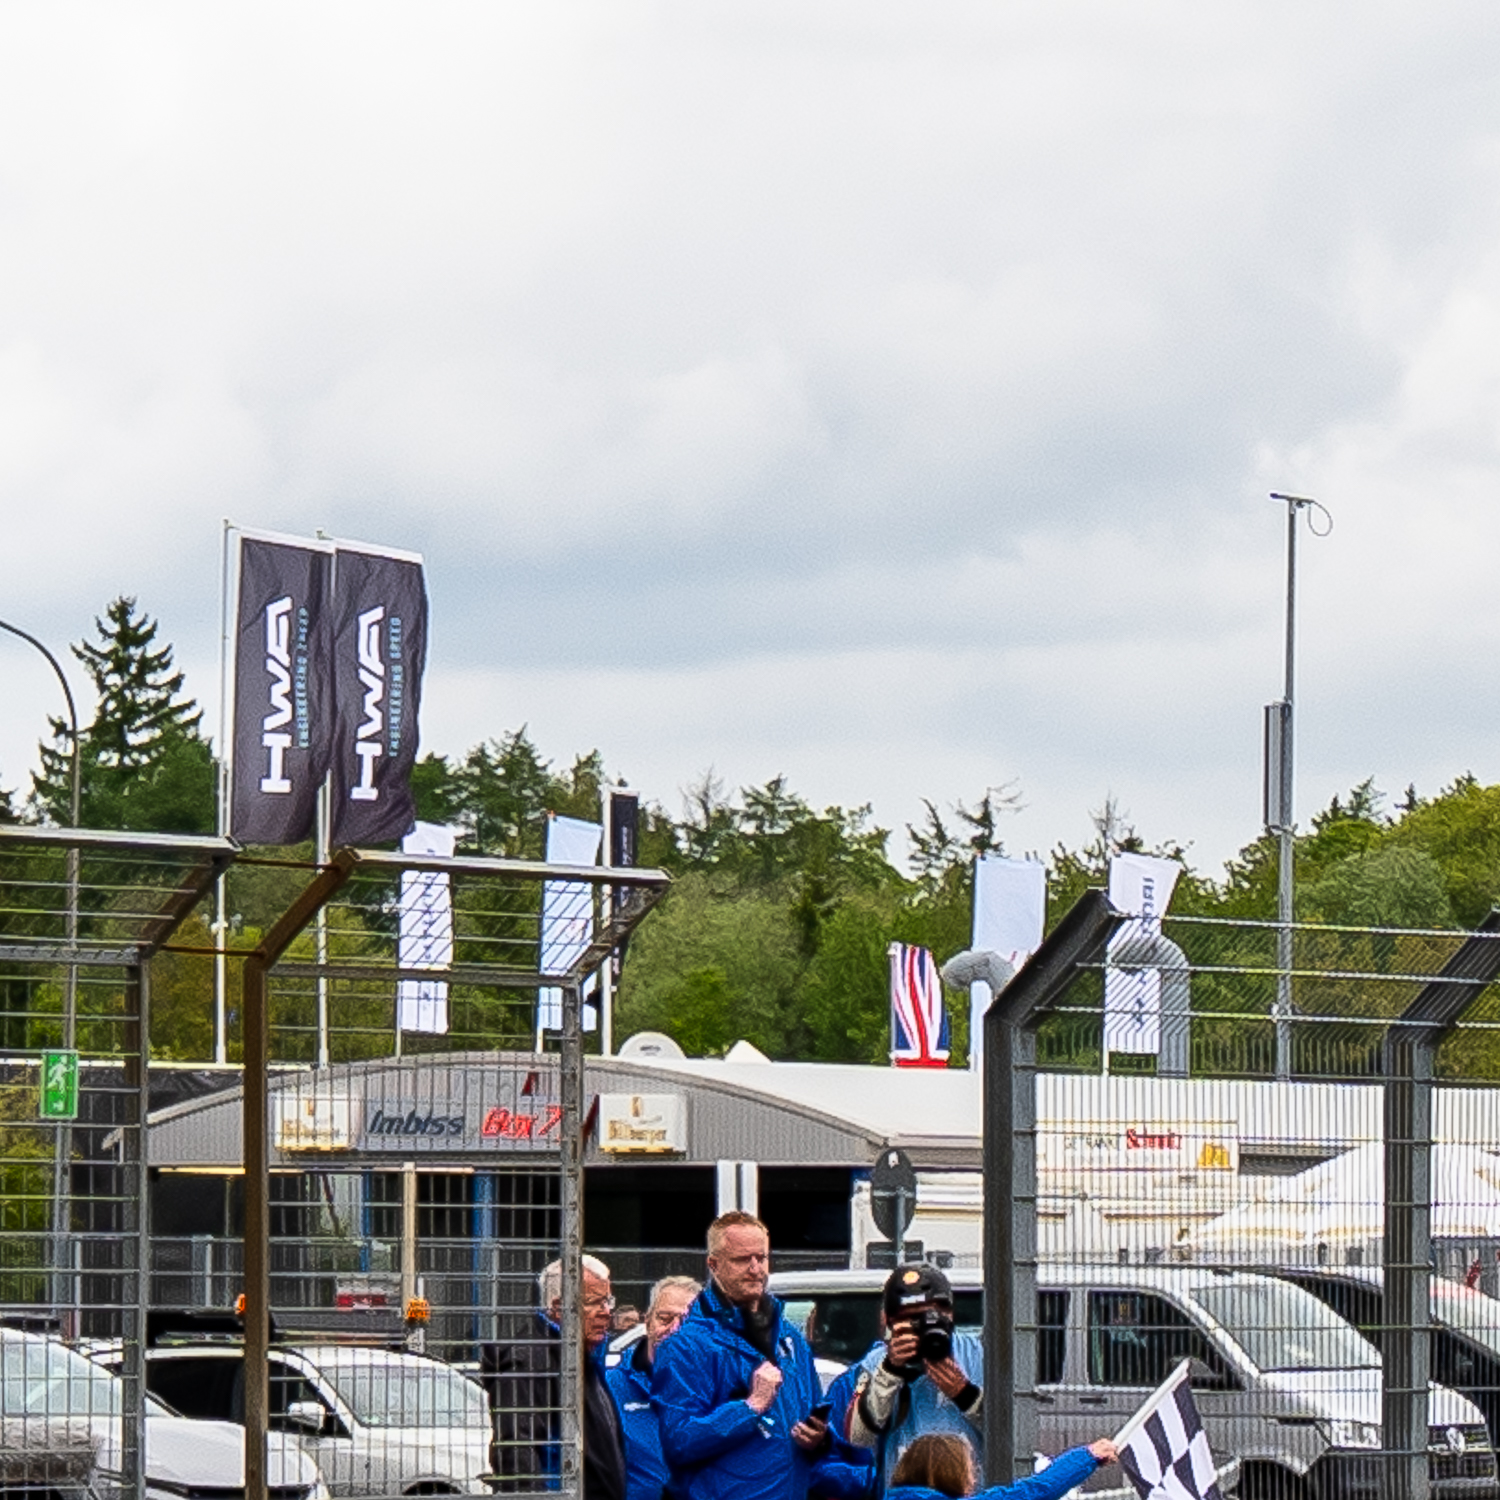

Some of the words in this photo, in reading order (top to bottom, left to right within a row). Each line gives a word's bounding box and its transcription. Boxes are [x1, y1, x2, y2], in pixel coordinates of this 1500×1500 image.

[261, 597, 292, 793] HWA
[351, 605, 385, 800] HWA
[369, 1110, 465, 1137] Imbiss
